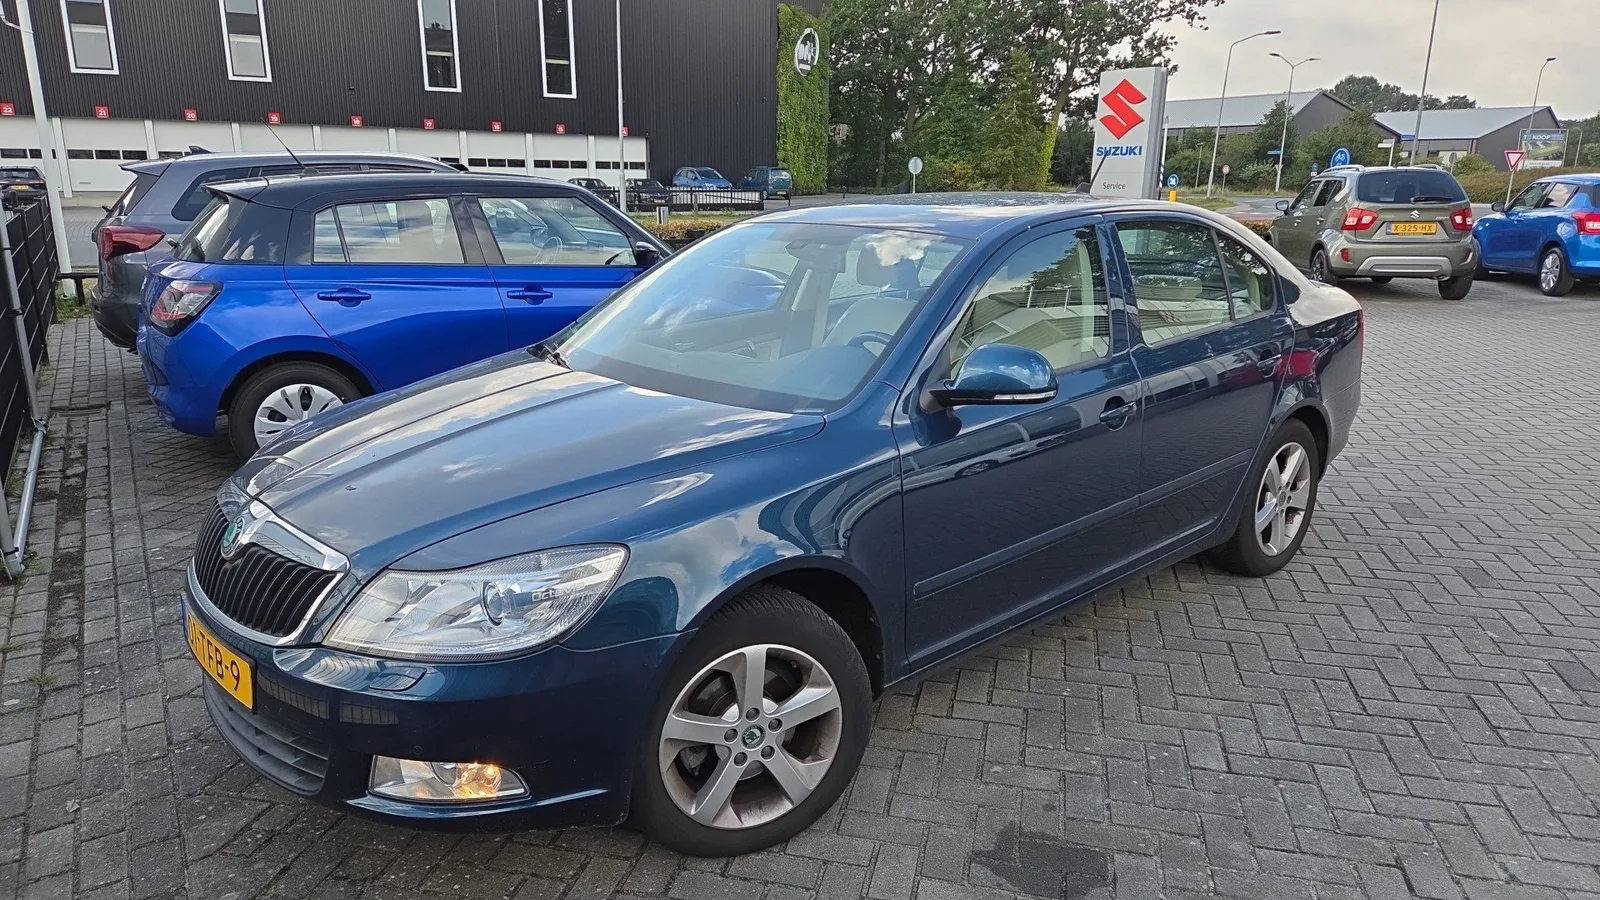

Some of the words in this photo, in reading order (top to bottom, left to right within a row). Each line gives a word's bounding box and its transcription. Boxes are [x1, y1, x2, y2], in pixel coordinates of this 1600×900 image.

[1096, 145, 1143, 157] SUZUKI
[1102, 181, 1126, 190] Service
[1393, 224, 1433, 232] X-325-HX
